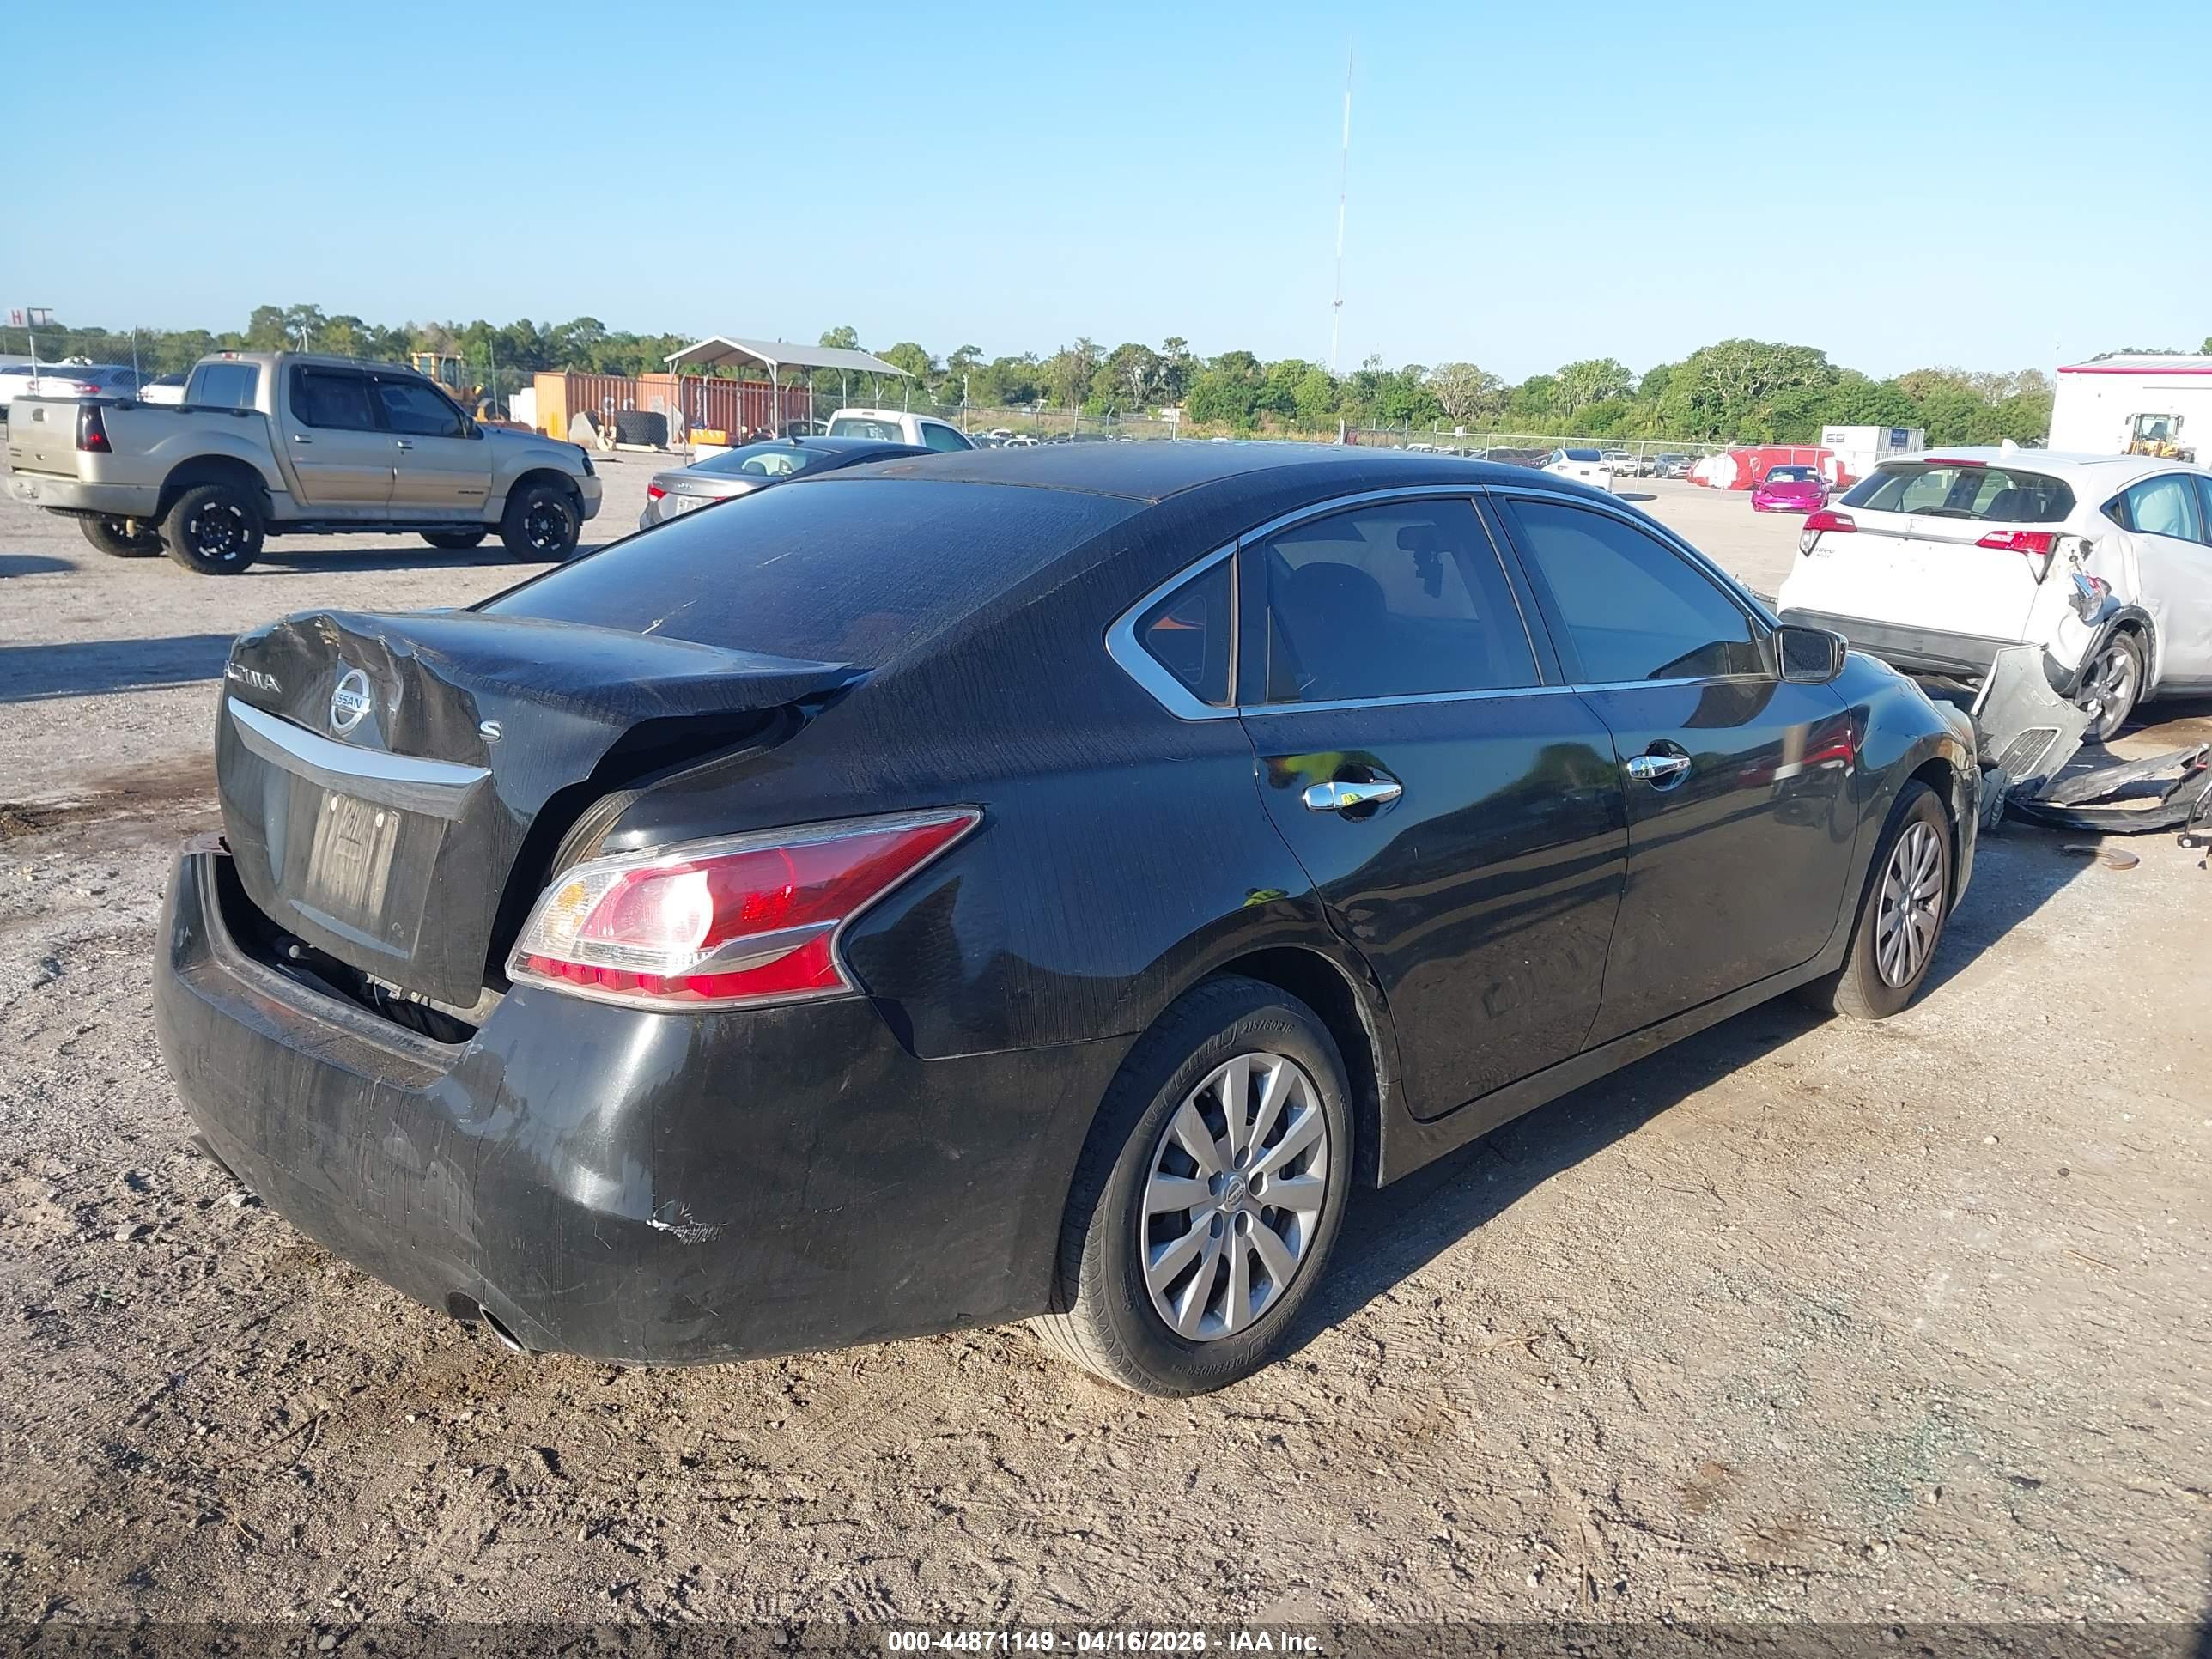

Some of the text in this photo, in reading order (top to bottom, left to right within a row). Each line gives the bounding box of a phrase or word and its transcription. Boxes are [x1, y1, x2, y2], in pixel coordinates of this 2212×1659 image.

[10, 308, 22, 325] H
[332, 693, 363, 708] ISSAN
[479, 720, 502, 743] S
